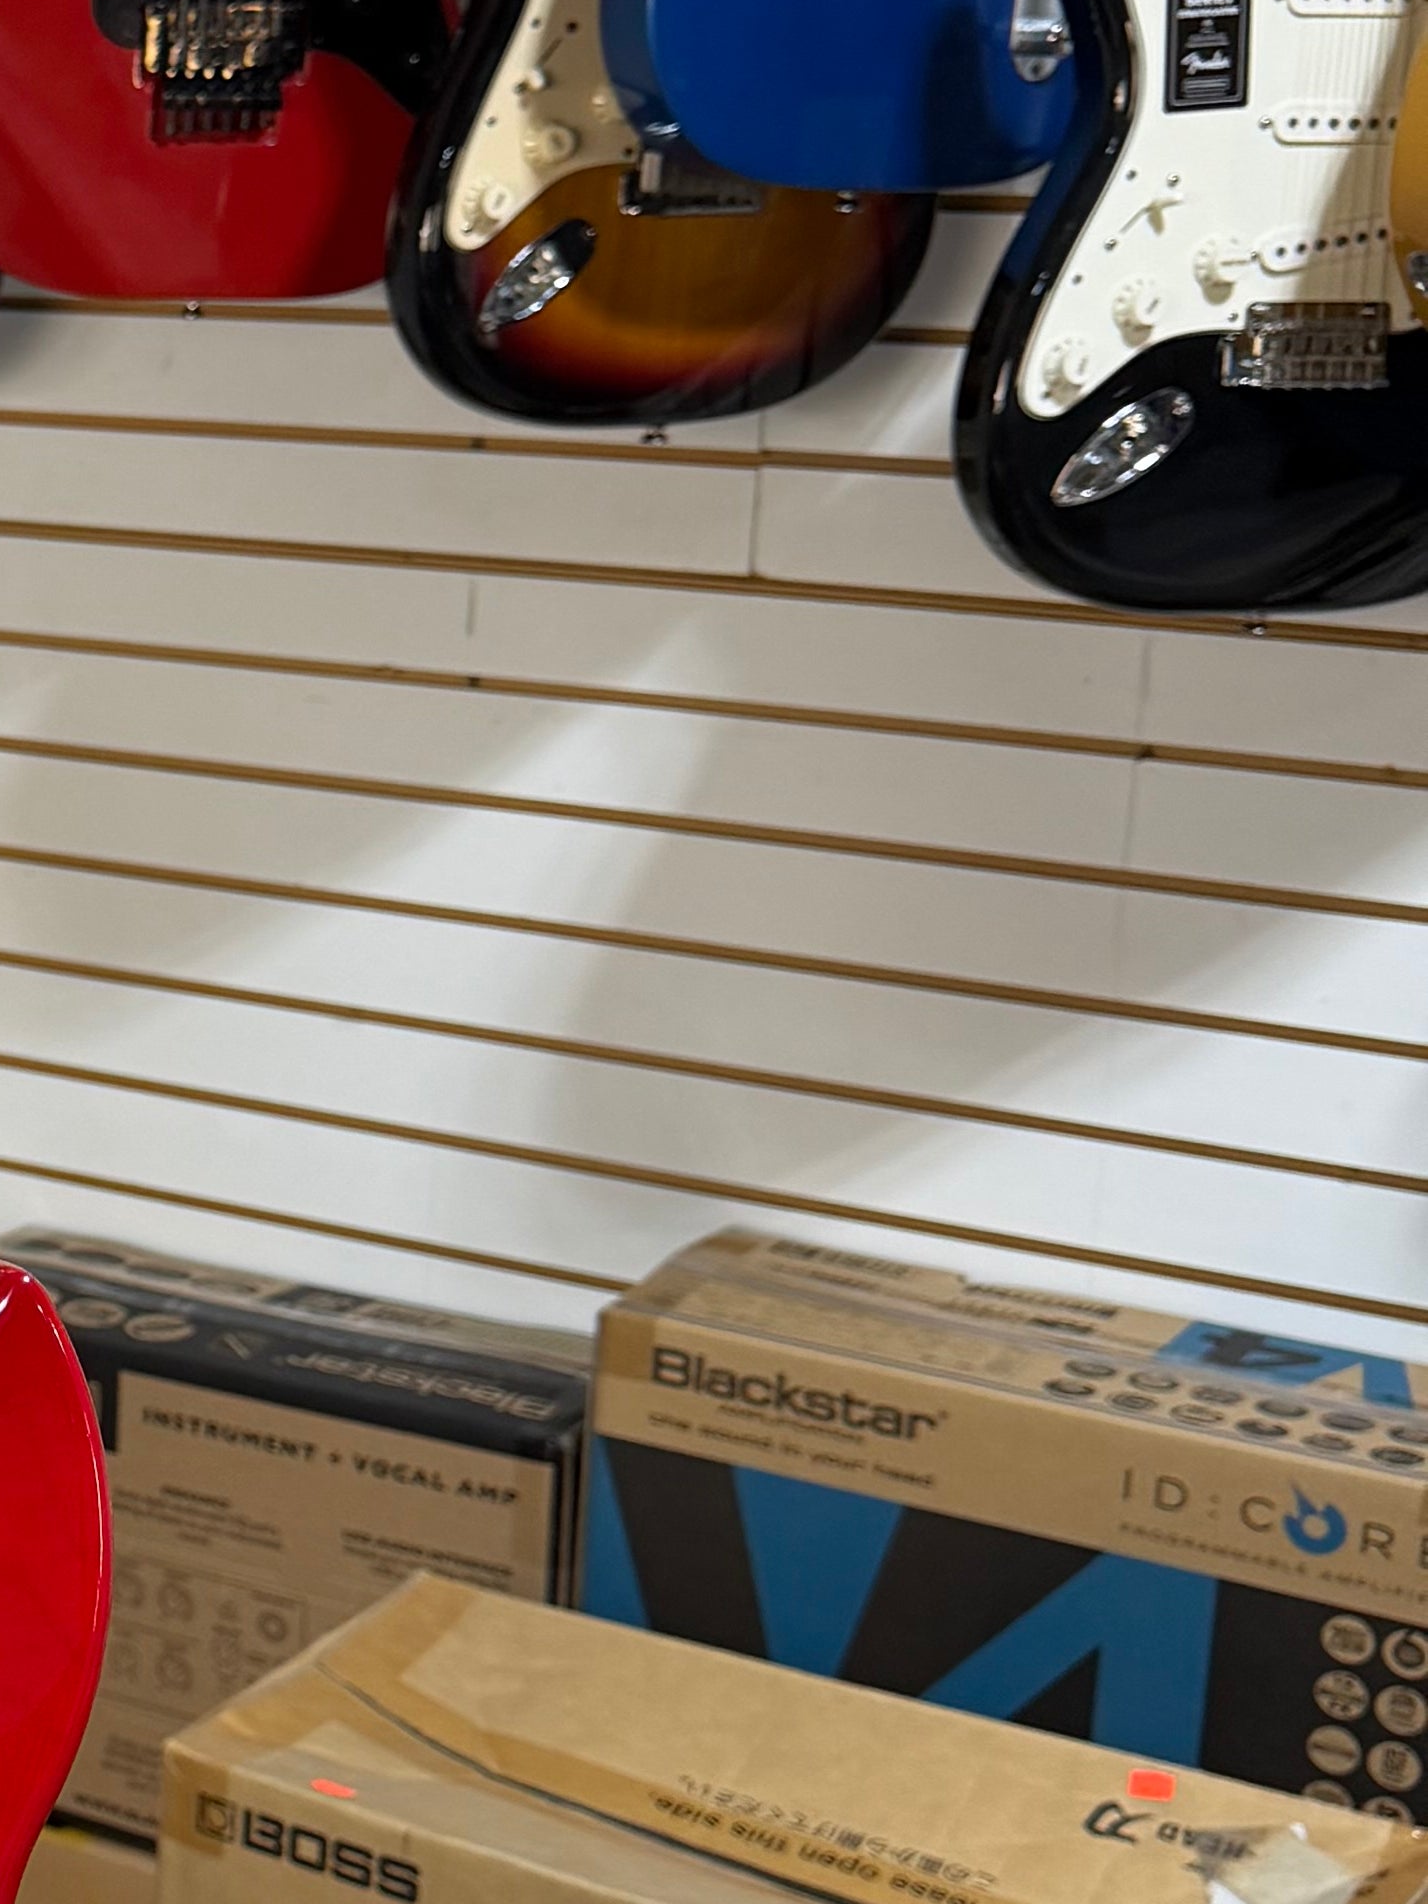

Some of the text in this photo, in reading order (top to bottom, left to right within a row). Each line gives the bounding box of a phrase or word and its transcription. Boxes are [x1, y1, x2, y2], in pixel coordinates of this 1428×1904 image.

[280, 1349, 558, 1423] Blackstar
[650, 1346, 939, 1440] Blackstar
[141, 1407, 319, 1464] INSTRUMENT
[352, 1453, 447, 1493] VOCAL
[456, 1476, 520, 1505] AMP
[243, 1807, 421, 1904] BOSS
[730, 1813, 790, 1857] this
[798, 1837, 883, 1886] open
